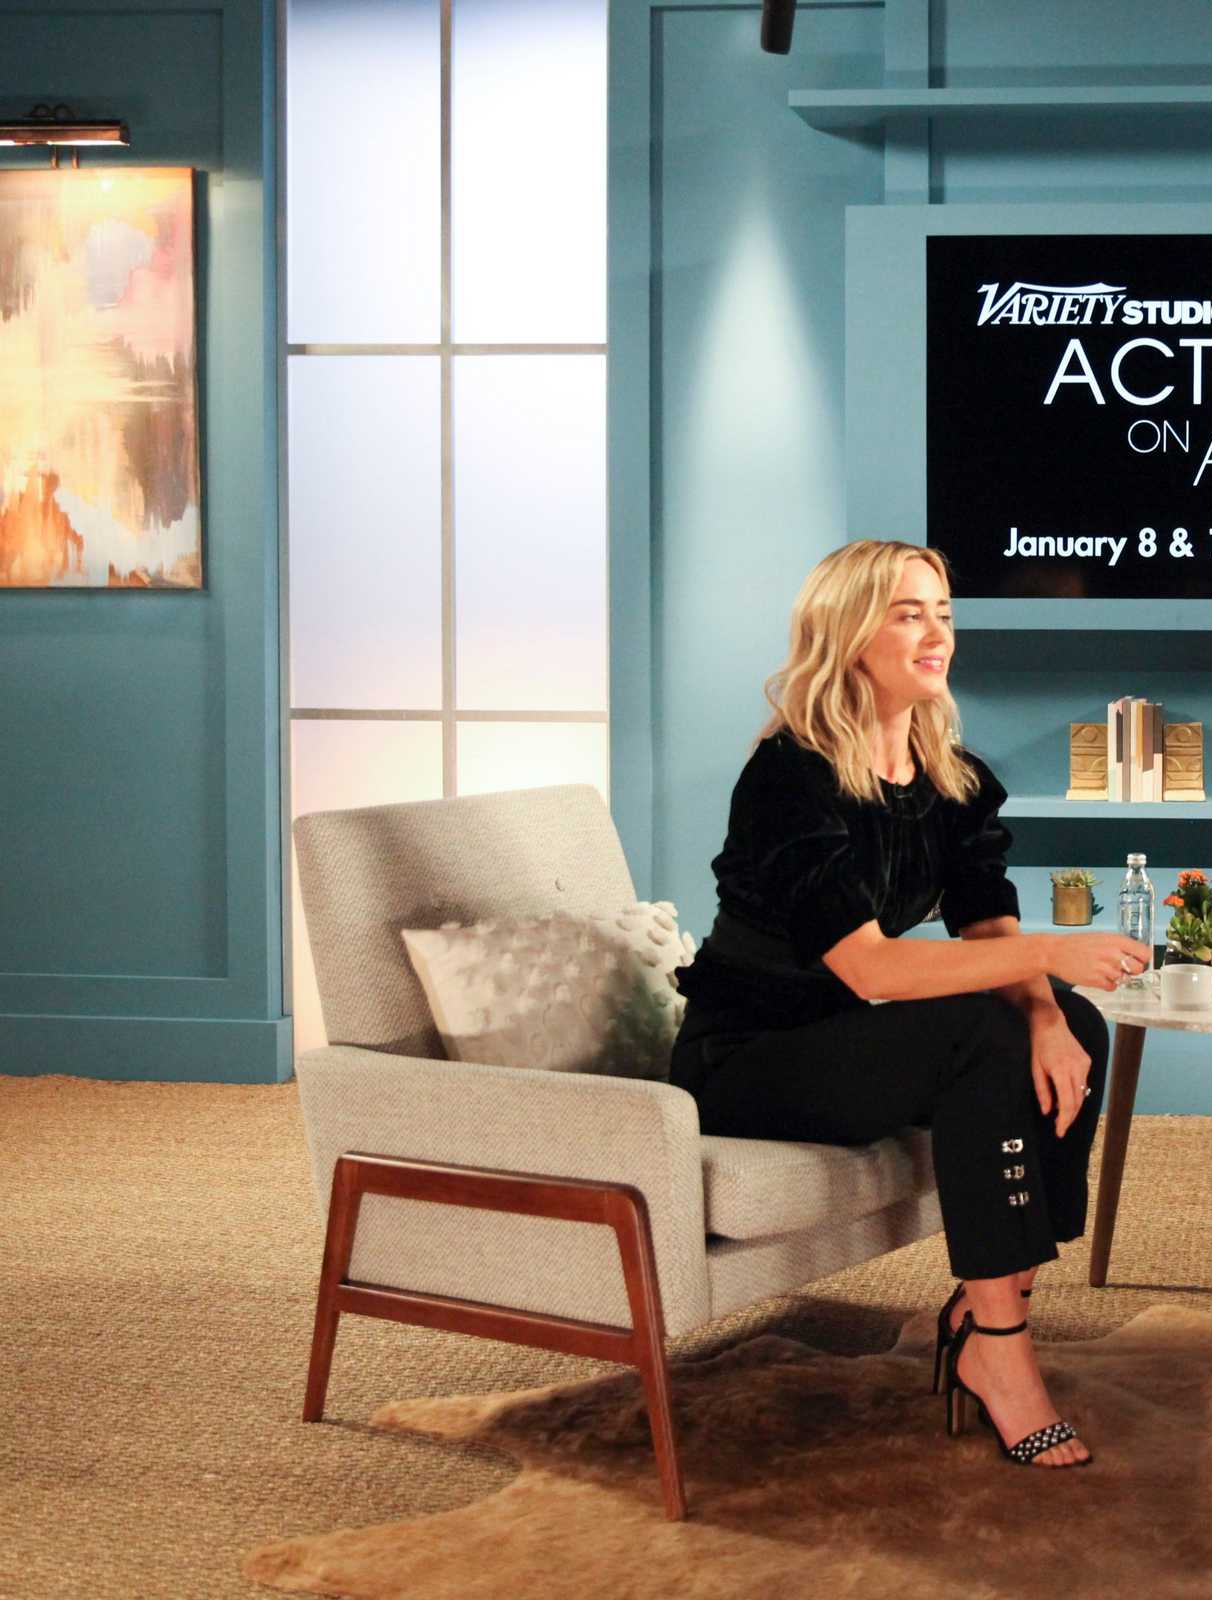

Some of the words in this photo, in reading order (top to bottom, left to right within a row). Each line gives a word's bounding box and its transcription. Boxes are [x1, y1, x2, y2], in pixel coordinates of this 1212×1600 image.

[977, 282, 1127, 326] VARIETY
[1128, 420, 1190, 453] ON
[1004, 527, 1127, 567] January
[1138, 527, 1157, 558] 8
[1168, 527, 1194, 558] &
